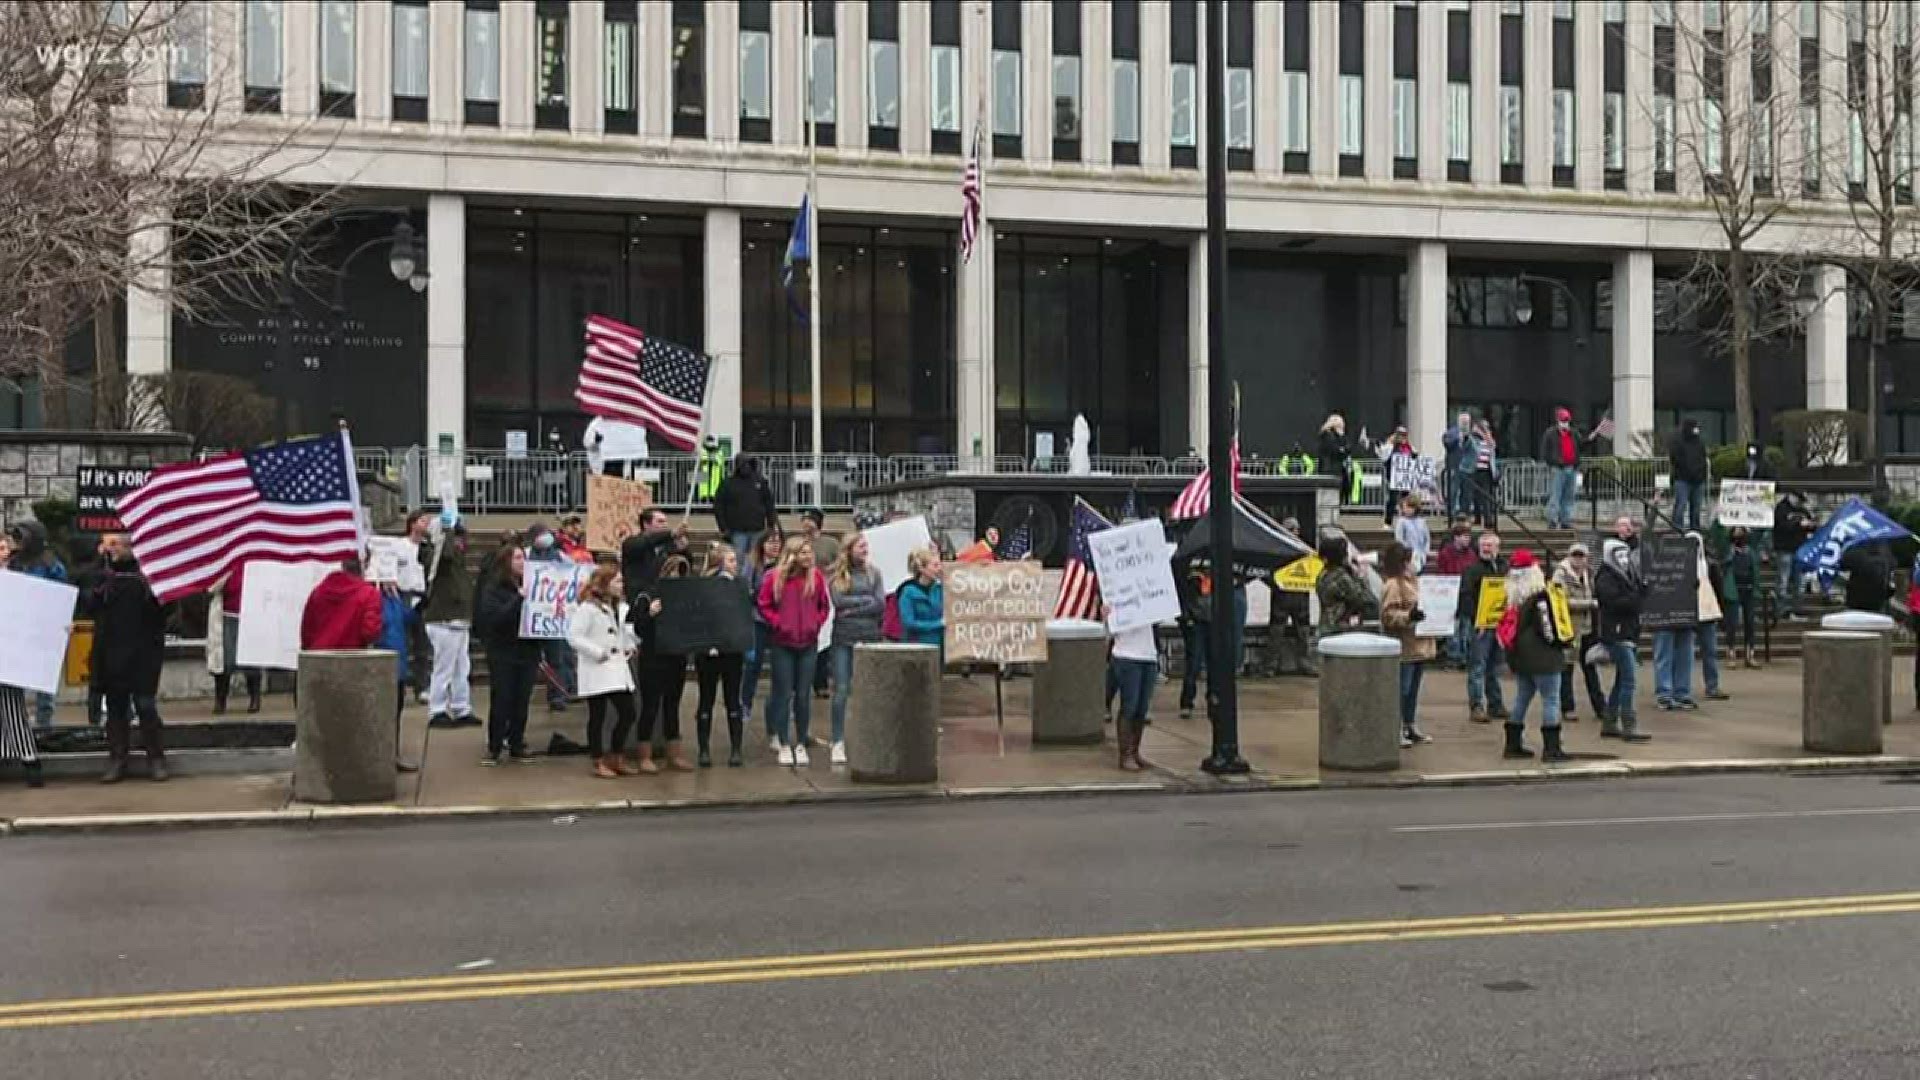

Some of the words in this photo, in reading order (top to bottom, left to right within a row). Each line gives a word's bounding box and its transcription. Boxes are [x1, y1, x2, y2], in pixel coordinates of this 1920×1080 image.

[304, 357, 320, 368] 95
[81, 469, 92, 486] If
[94, 469, 115, 486] it's
[79, 496, 103, 508] are
[952, 570, 1002, 598] Stop
[955, 621, 1037, 642] REOPEN
